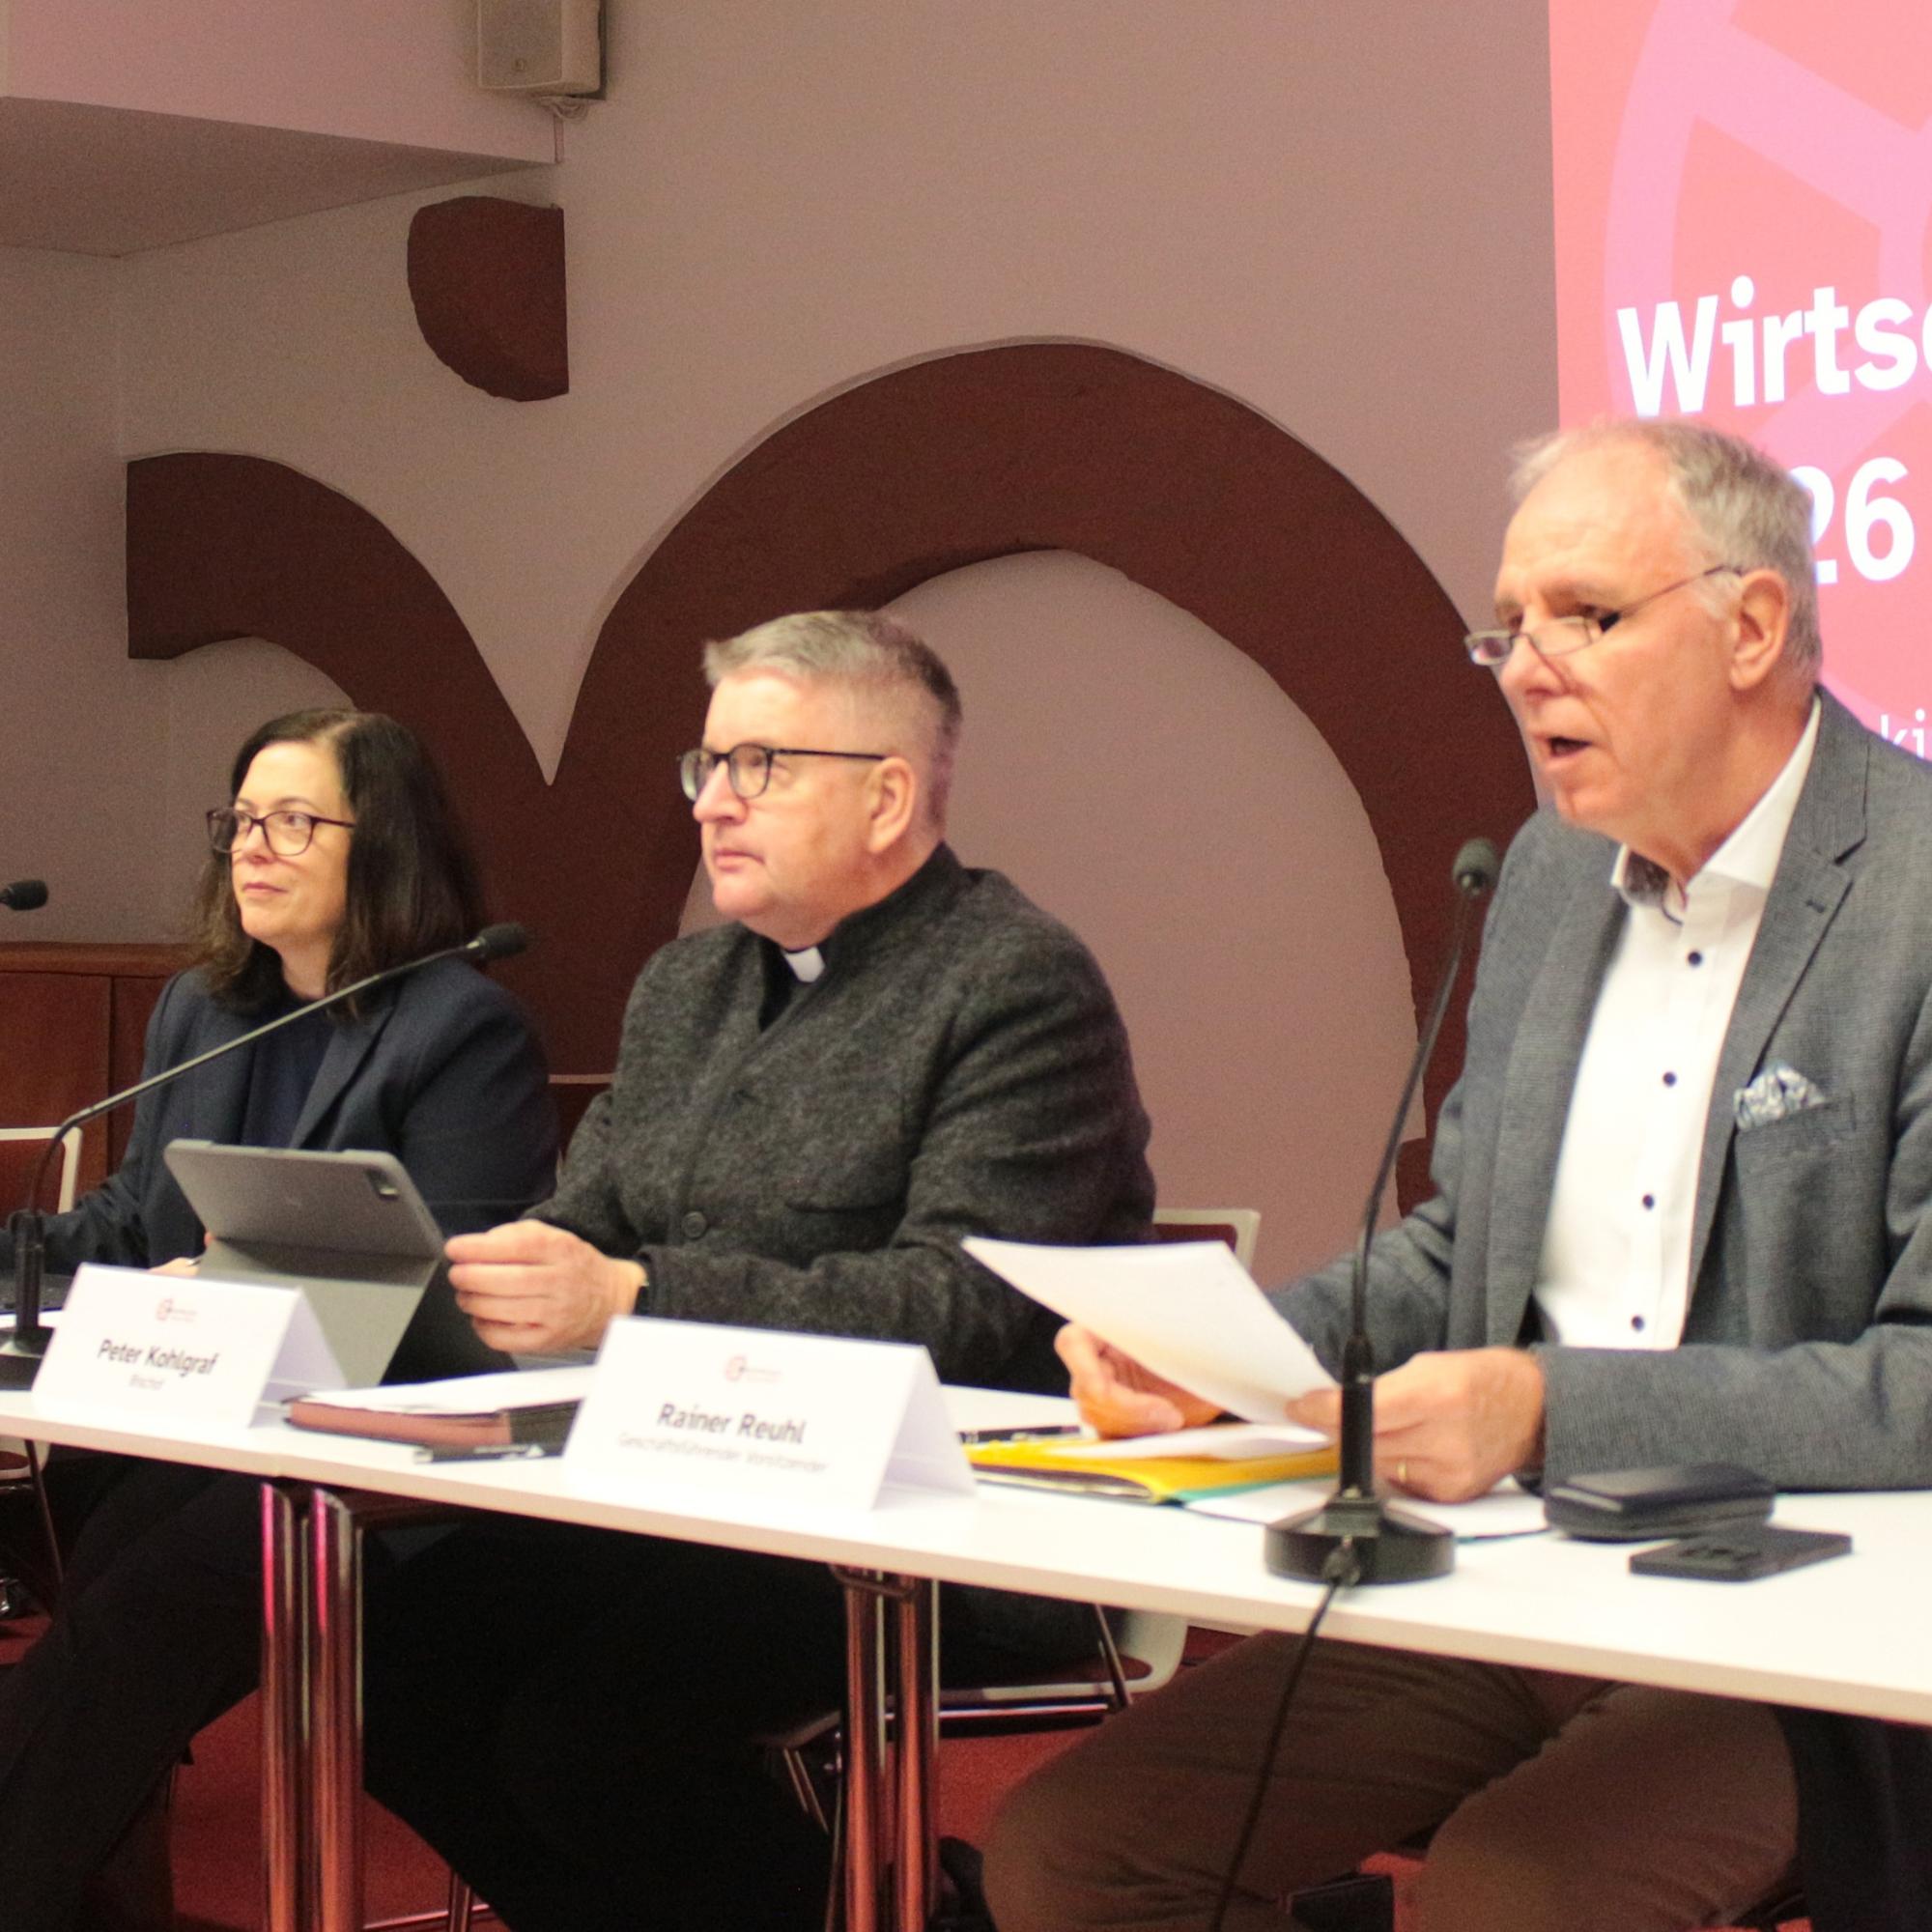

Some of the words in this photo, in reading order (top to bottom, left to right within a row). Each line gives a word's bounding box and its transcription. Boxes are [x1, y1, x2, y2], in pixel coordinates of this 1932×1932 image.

[1616, 275, 1932, 418] Wirts
[98, 1339, 143, 1364] Peter
[144, 1346, 220, 1378] Kohlgraf
[657, 1401, 732, 1435] Rainer
[736, 1412, 808, 1445] Reuhl
